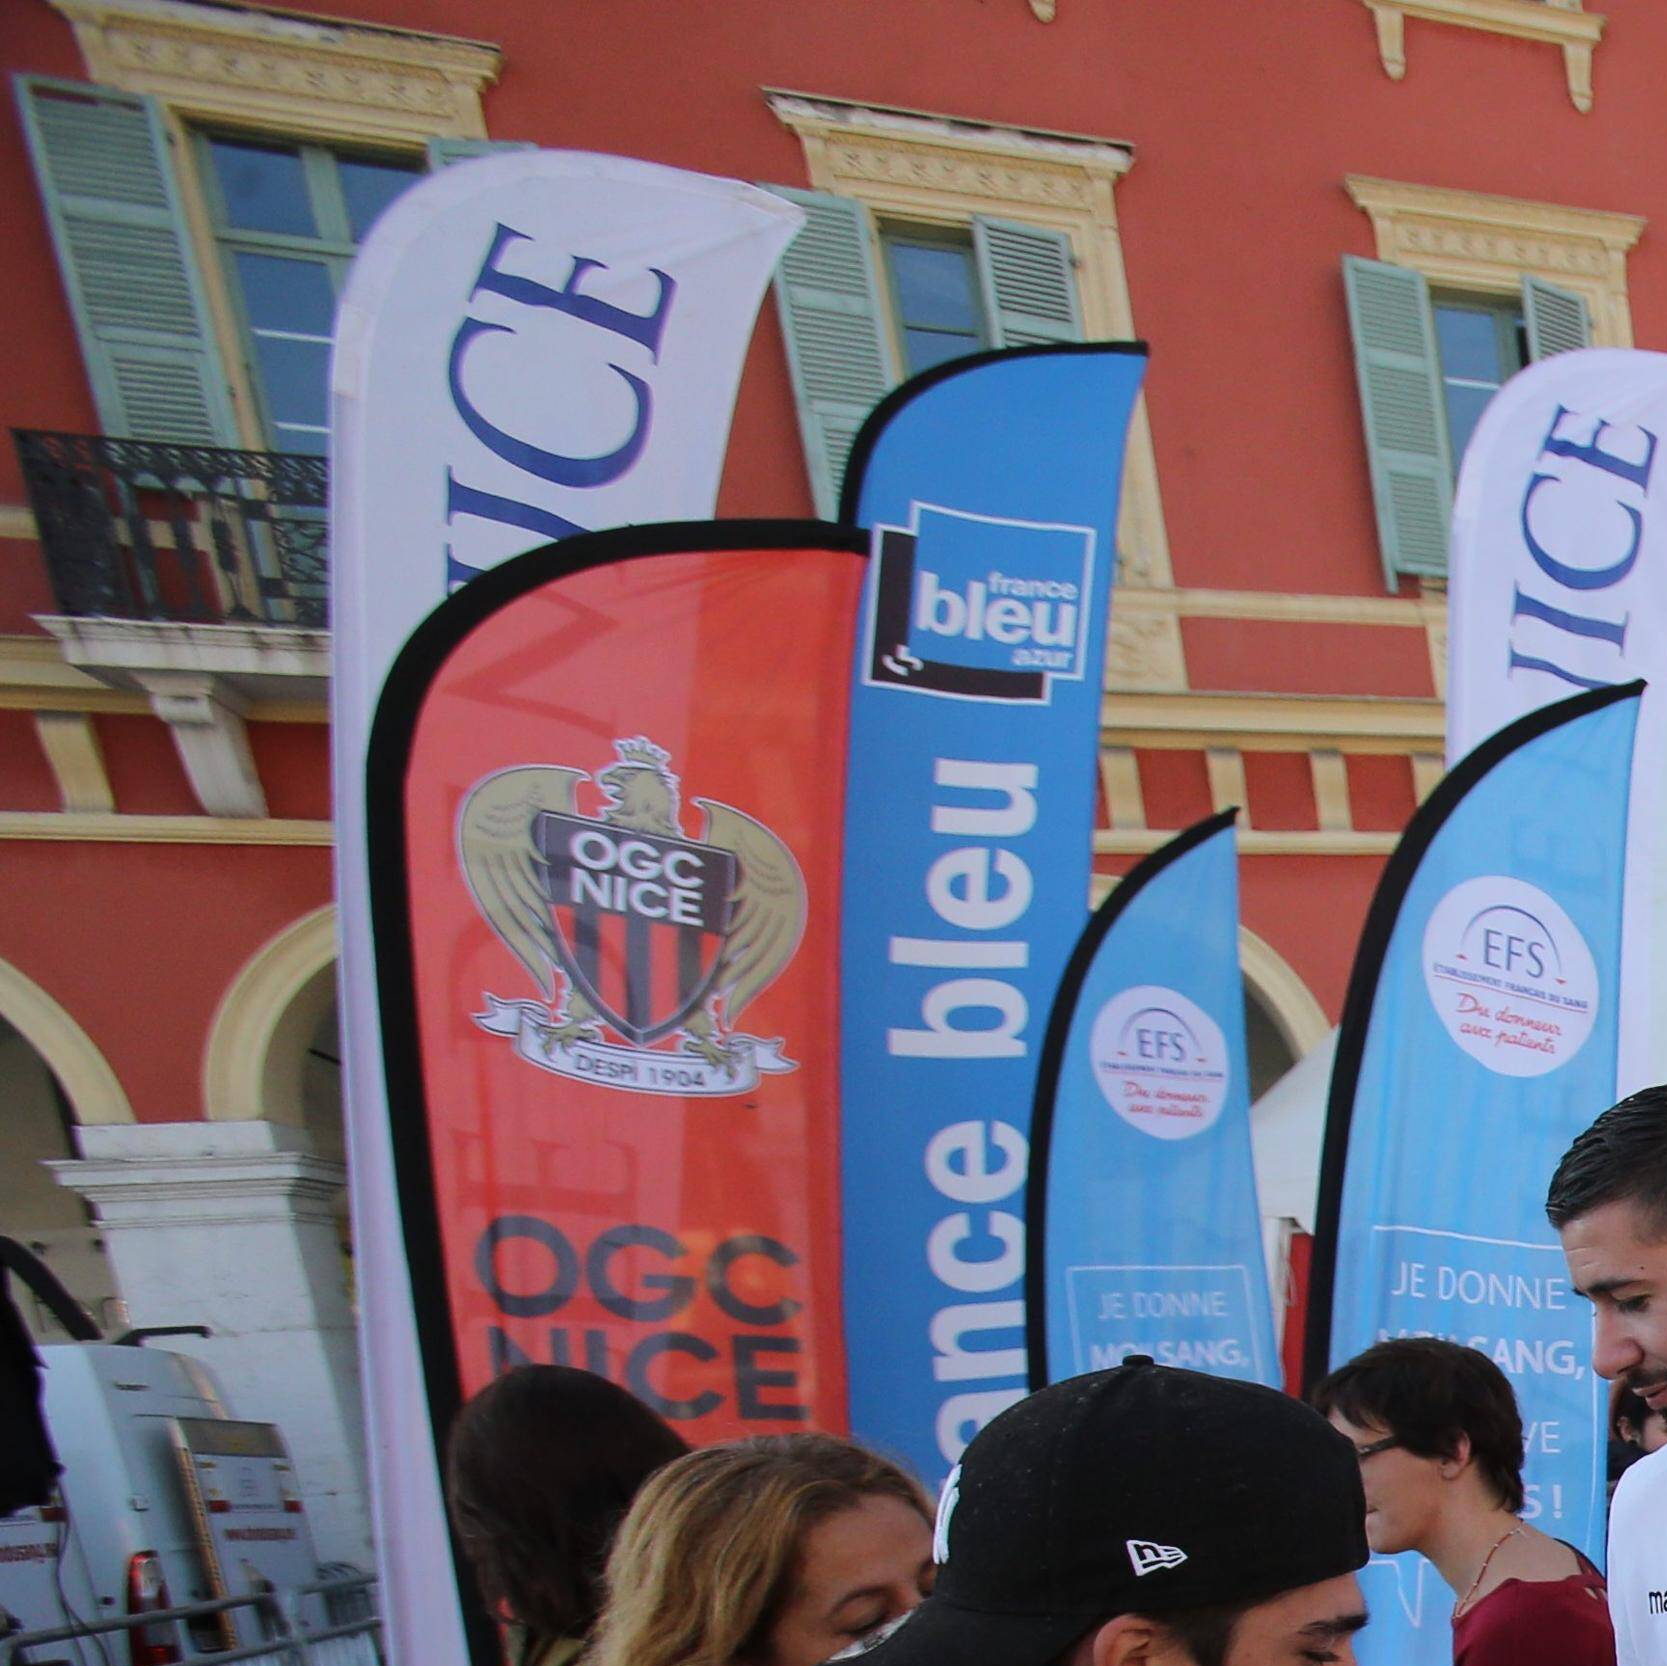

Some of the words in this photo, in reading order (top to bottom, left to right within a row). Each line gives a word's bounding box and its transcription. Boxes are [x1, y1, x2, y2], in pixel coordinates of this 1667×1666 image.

[914, 569, 1077, 647] bleu
[987, 570, 1078, 599] france
[1010, 647, 1073, 669] azur
[569, 830, 705, 888] OGC
[570, 866, 705, 927] NICE
[887, 757, 1038, 1058] bleu
[1483, 928, 1546, 979] EFS
[1136, 1028, 1187, 1062] EFS
[648, 1066, 706, 1088] 1904
[474, 1214, 803, 1326] OGC
[924, 1119, 1031, 1455] ance
[1391, 1261, 1427, 1299] JE
[1437, 1264, 1567, 1310] DONNE
[1098, 1292, 1127, 1320] JE
[1132, 1291, 1229, 1319] DONNE
